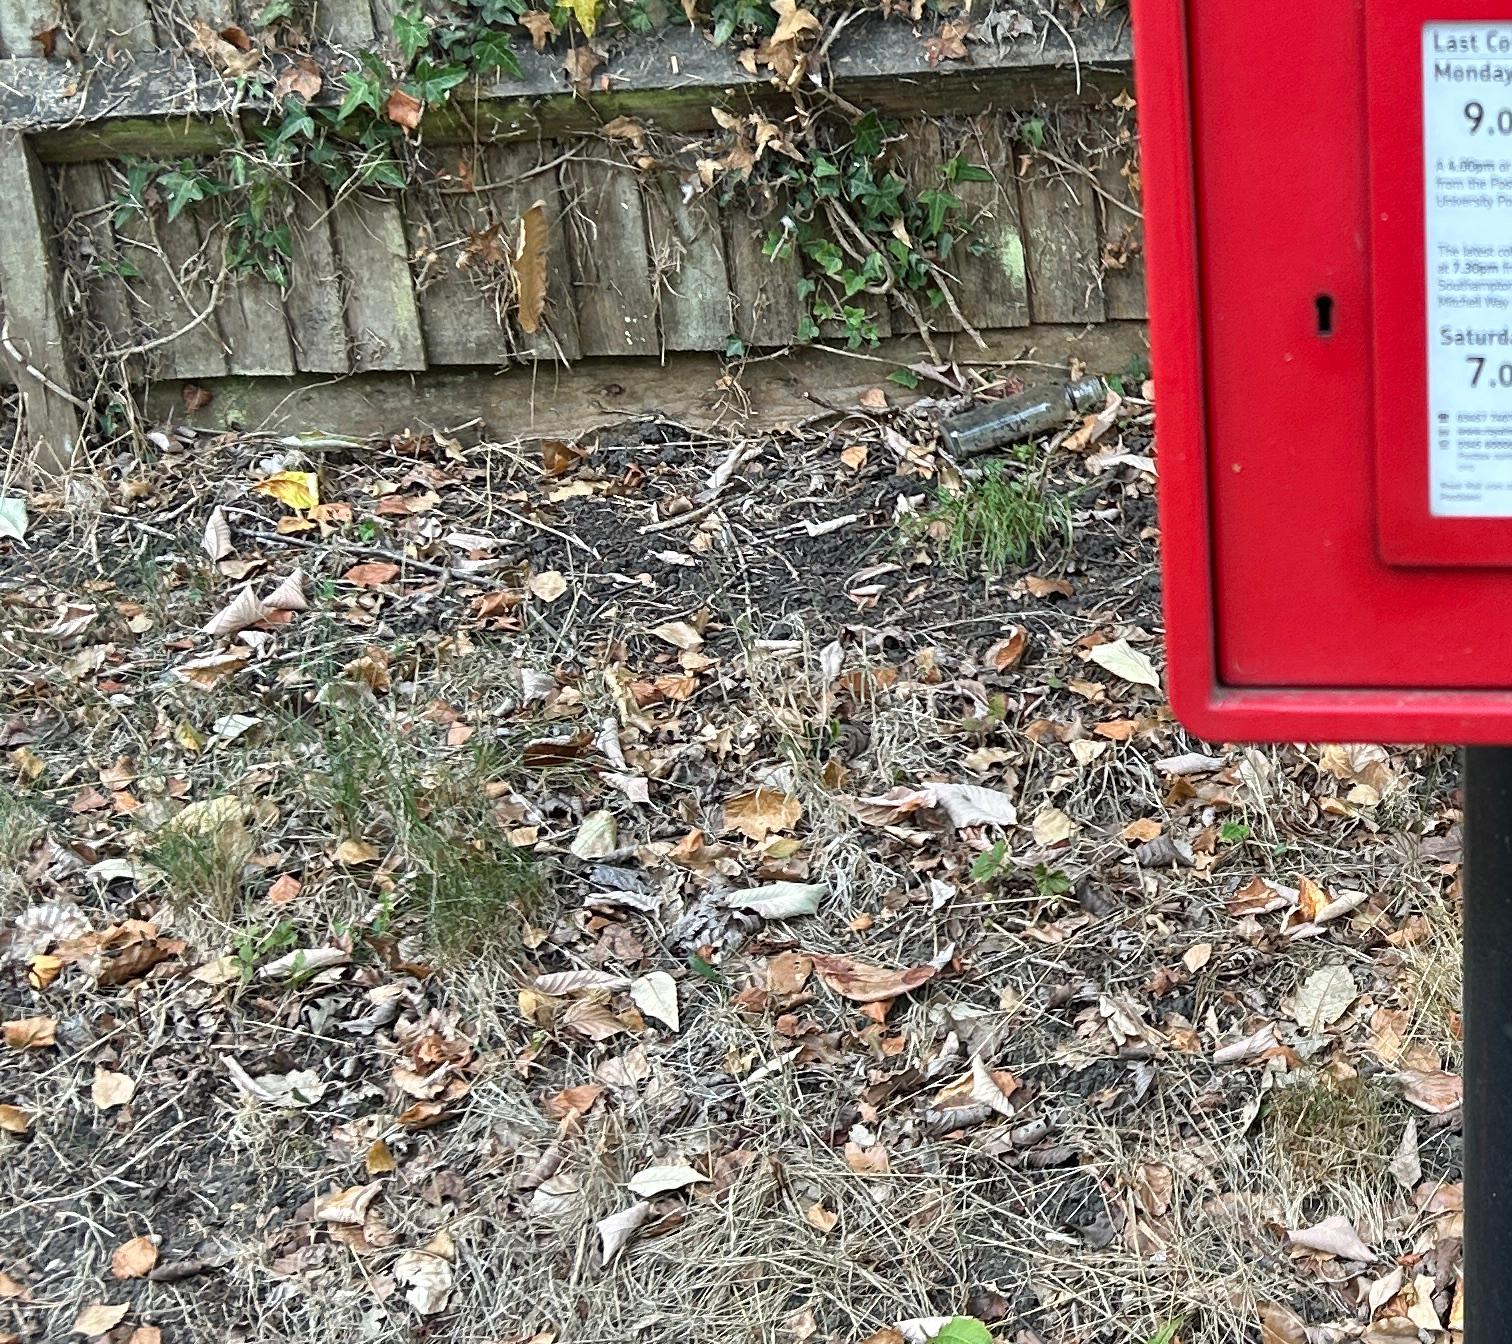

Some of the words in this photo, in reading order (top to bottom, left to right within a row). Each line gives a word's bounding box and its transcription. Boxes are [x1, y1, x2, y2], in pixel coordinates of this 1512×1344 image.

[1433, 30, 1478, 52] Last
[1499, 162, 1511, 172] or
[1436, 178, 1464, 190] from
[1468, 178, 1487, 190] the
[1437, 196, 1493, 209] University
[1439, 246, 1459, 257] The
[1464, 246, 1494, 257] latest
[1438, 264, 1449, 274] at
[1453, 262, 1499, 276] 7.30pm
[1485, 297, 1509, 309] Way
